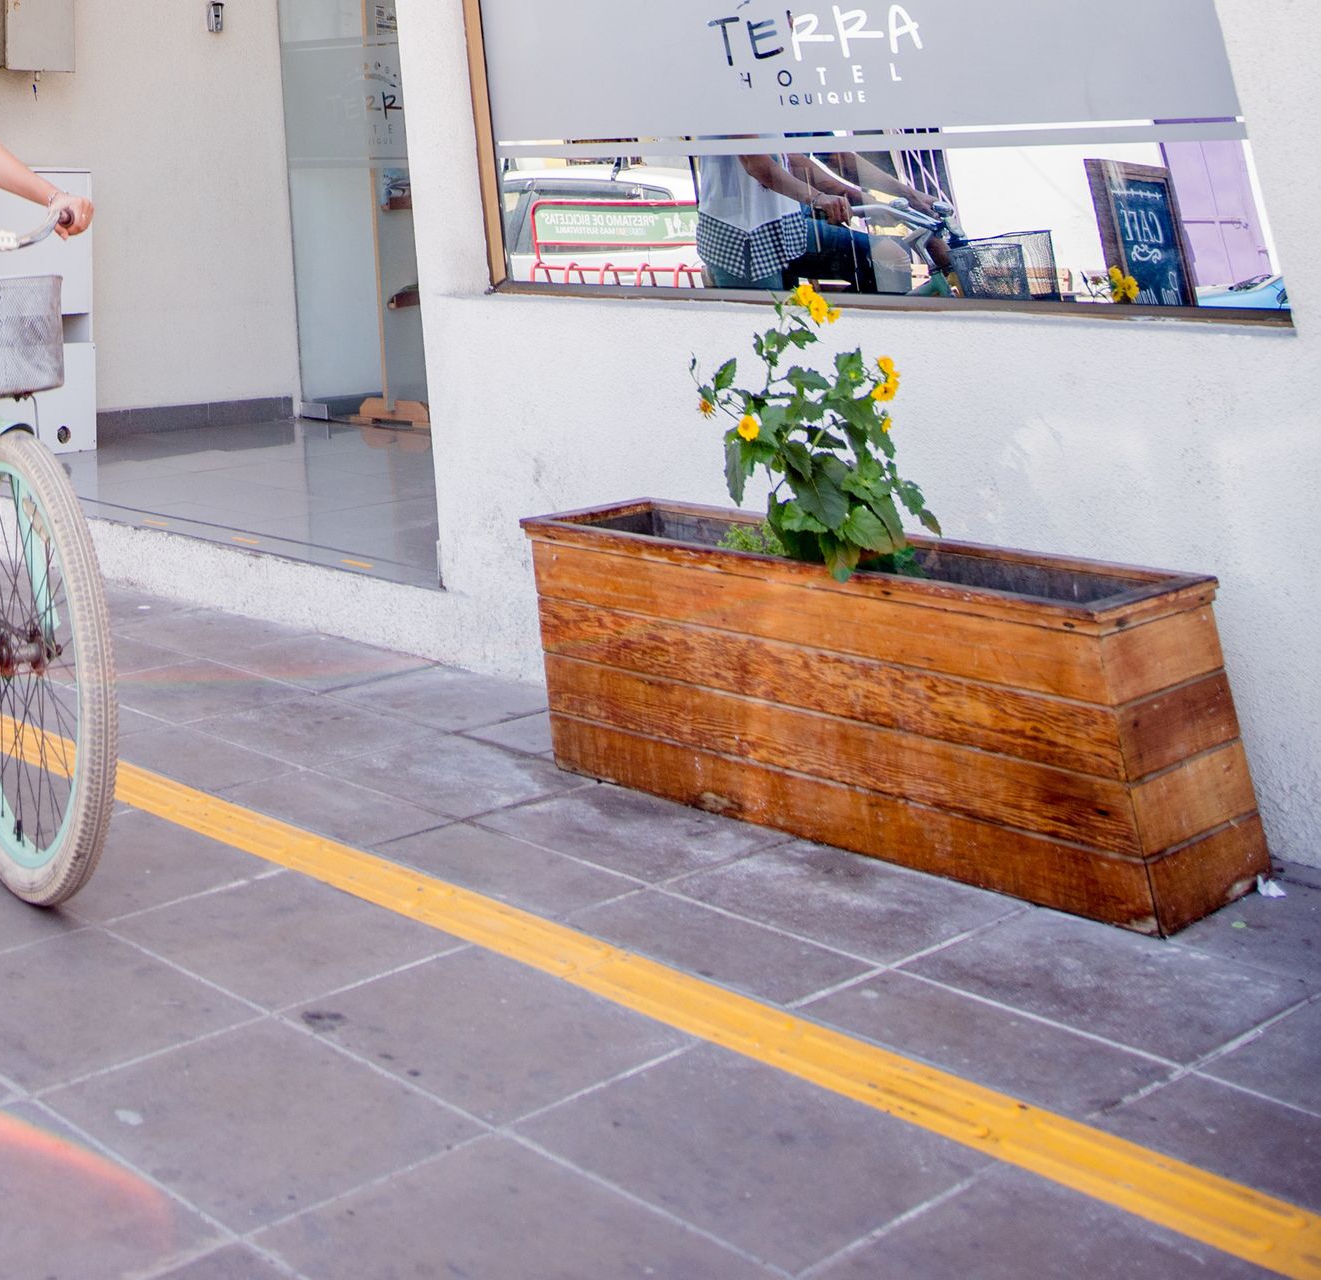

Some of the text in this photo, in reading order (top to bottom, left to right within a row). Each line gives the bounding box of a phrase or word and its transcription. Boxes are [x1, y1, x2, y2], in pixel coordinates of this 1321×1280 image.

[707, 4, 923, 66] TERRA
[739, 63, 902, 88] HOTEL
[779, 90, 867, 105] IQUIQUE
